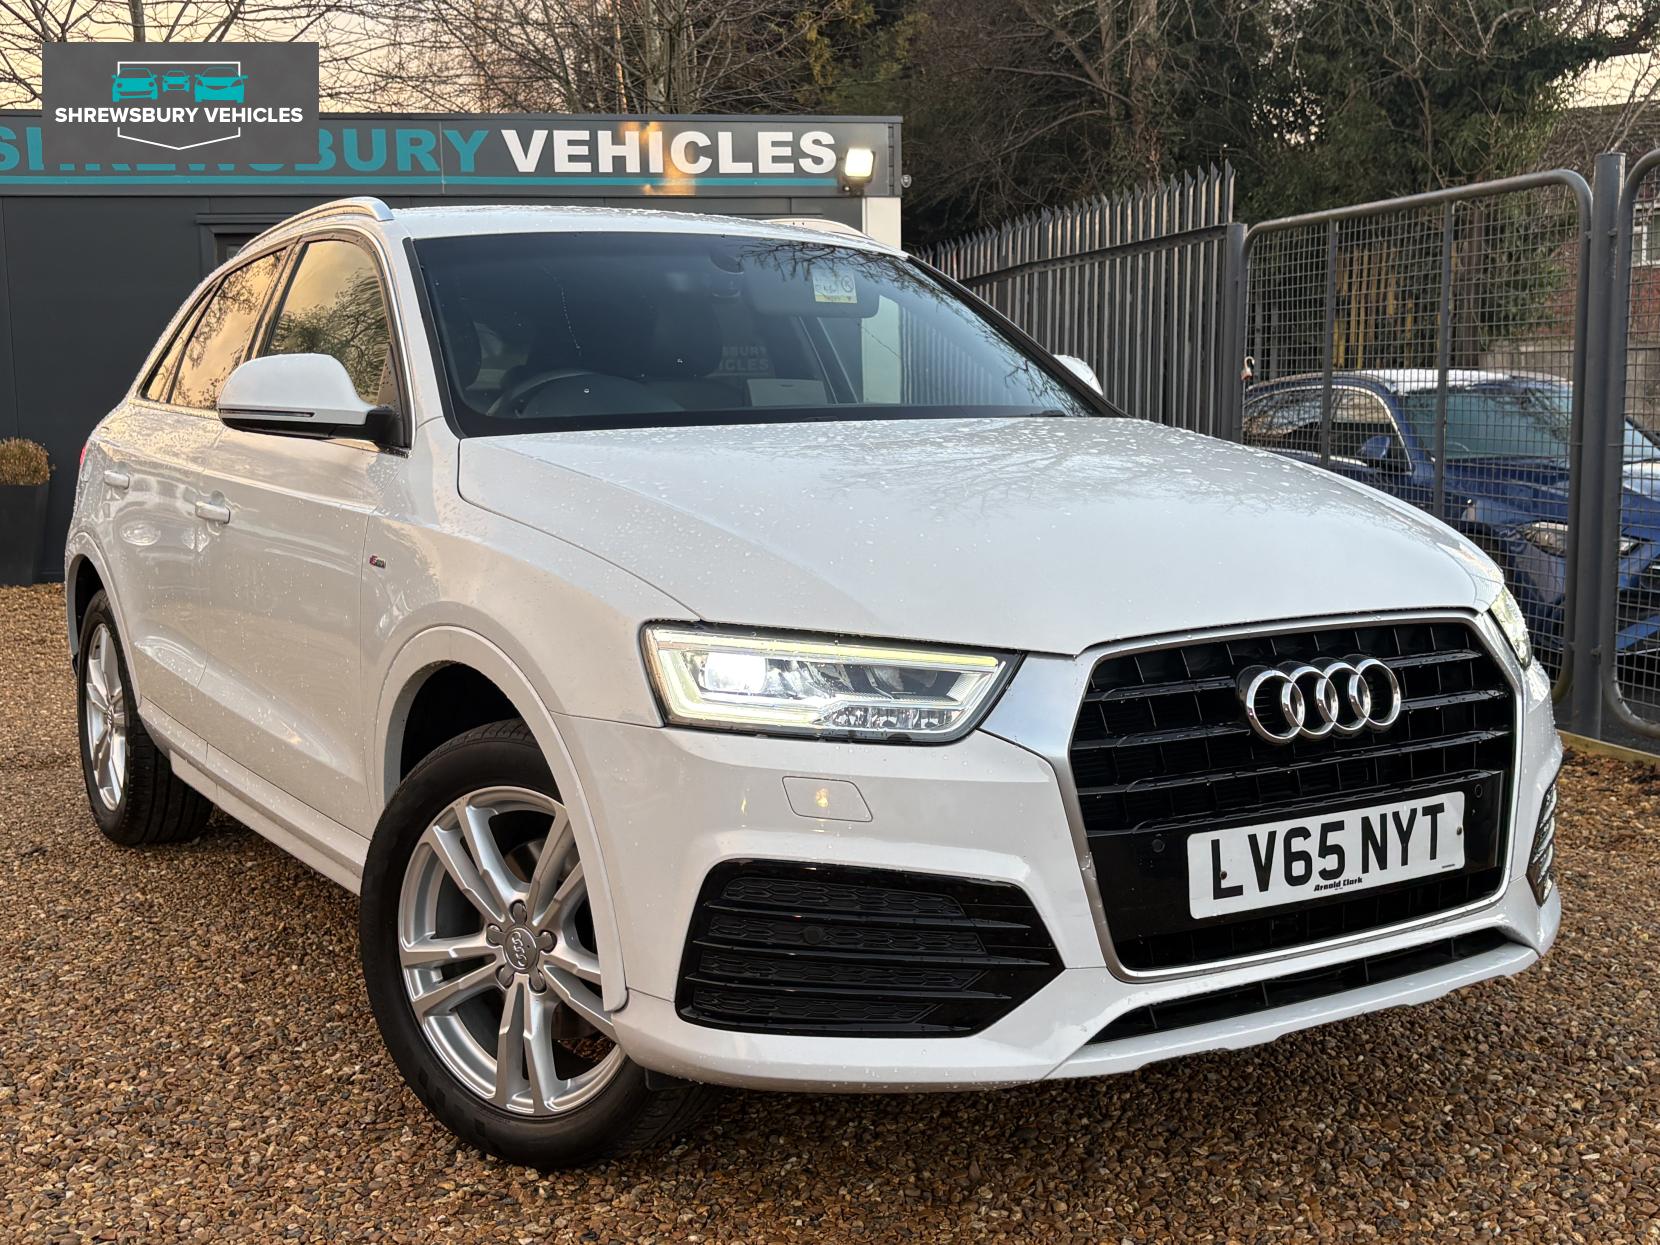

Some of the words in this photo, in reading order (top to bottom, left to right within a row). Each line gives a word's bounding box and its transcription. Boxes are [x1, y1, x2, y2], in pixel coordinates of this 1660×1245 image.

[501, 129, 838, 174] VEHICLES
[1210, 819, 1346, 900] LV65
[1361, 802, 1445, 874] NYT
[1314, 880, 1342, 892] Arnold
[1342, 876, 1363, 886] Clark
